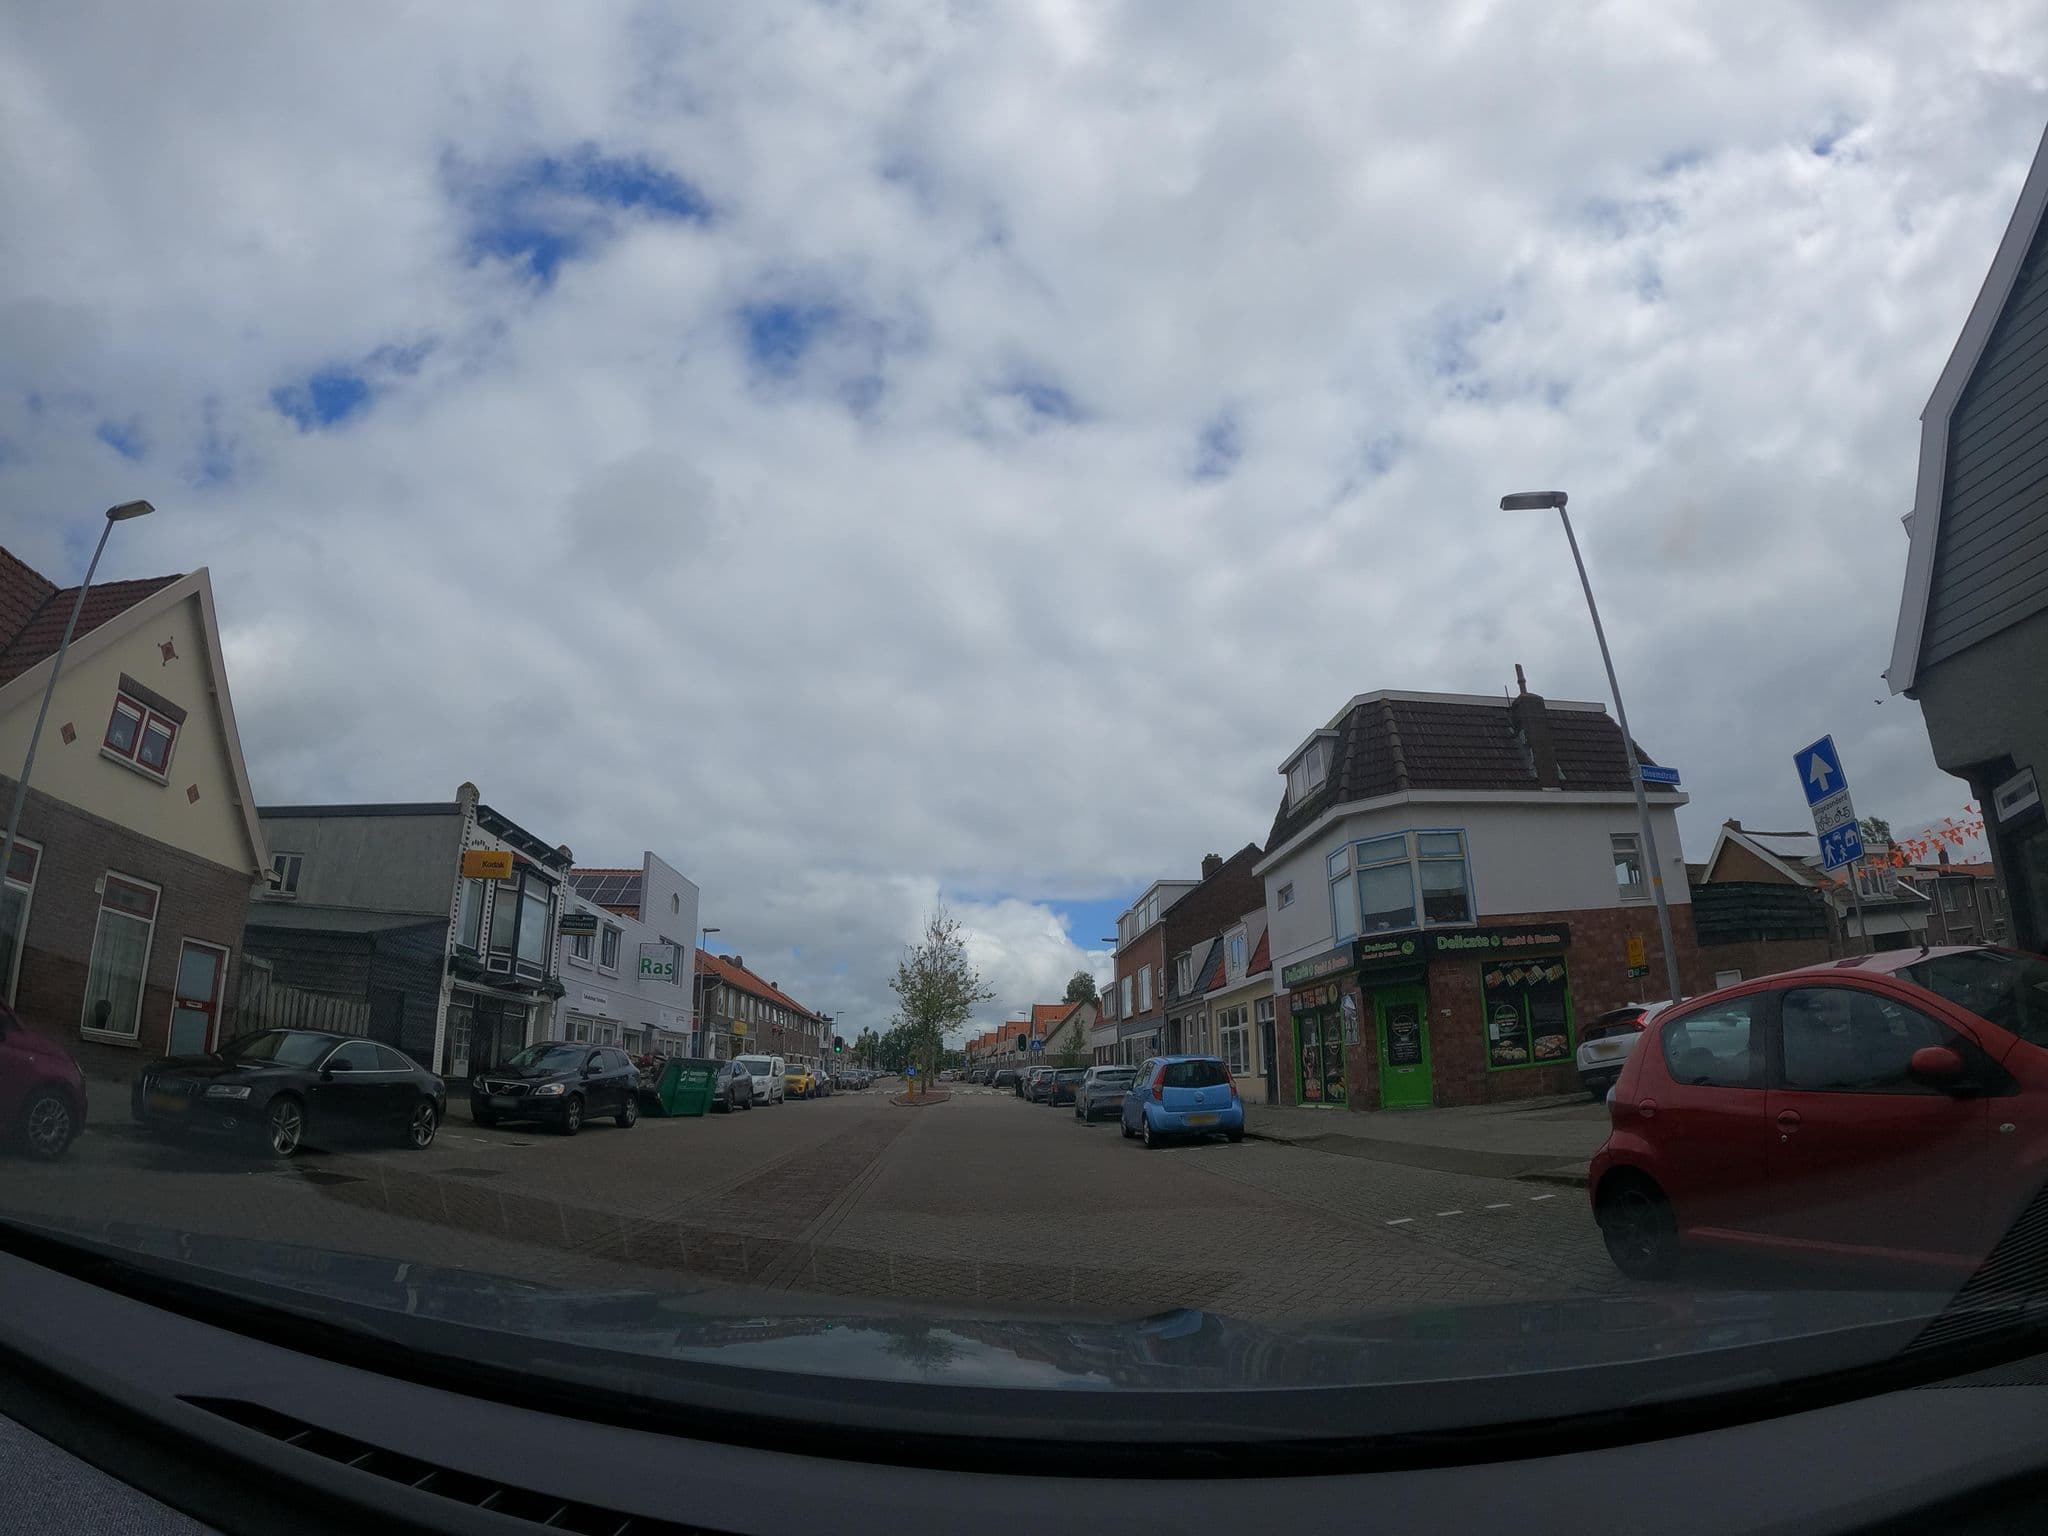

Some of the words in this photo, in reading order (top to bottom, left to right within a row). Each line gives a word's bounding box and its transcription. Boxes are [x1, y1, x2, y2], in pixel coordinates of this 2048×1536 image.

[481, 861, 504, 869] Kodak
[1364, 942, 1397, 952] Delicate
[1437, 935, 1490, 950] Delicate
[640, 957, 673, 975] Ras
[1285, 965, 1308, 984] Delicate
